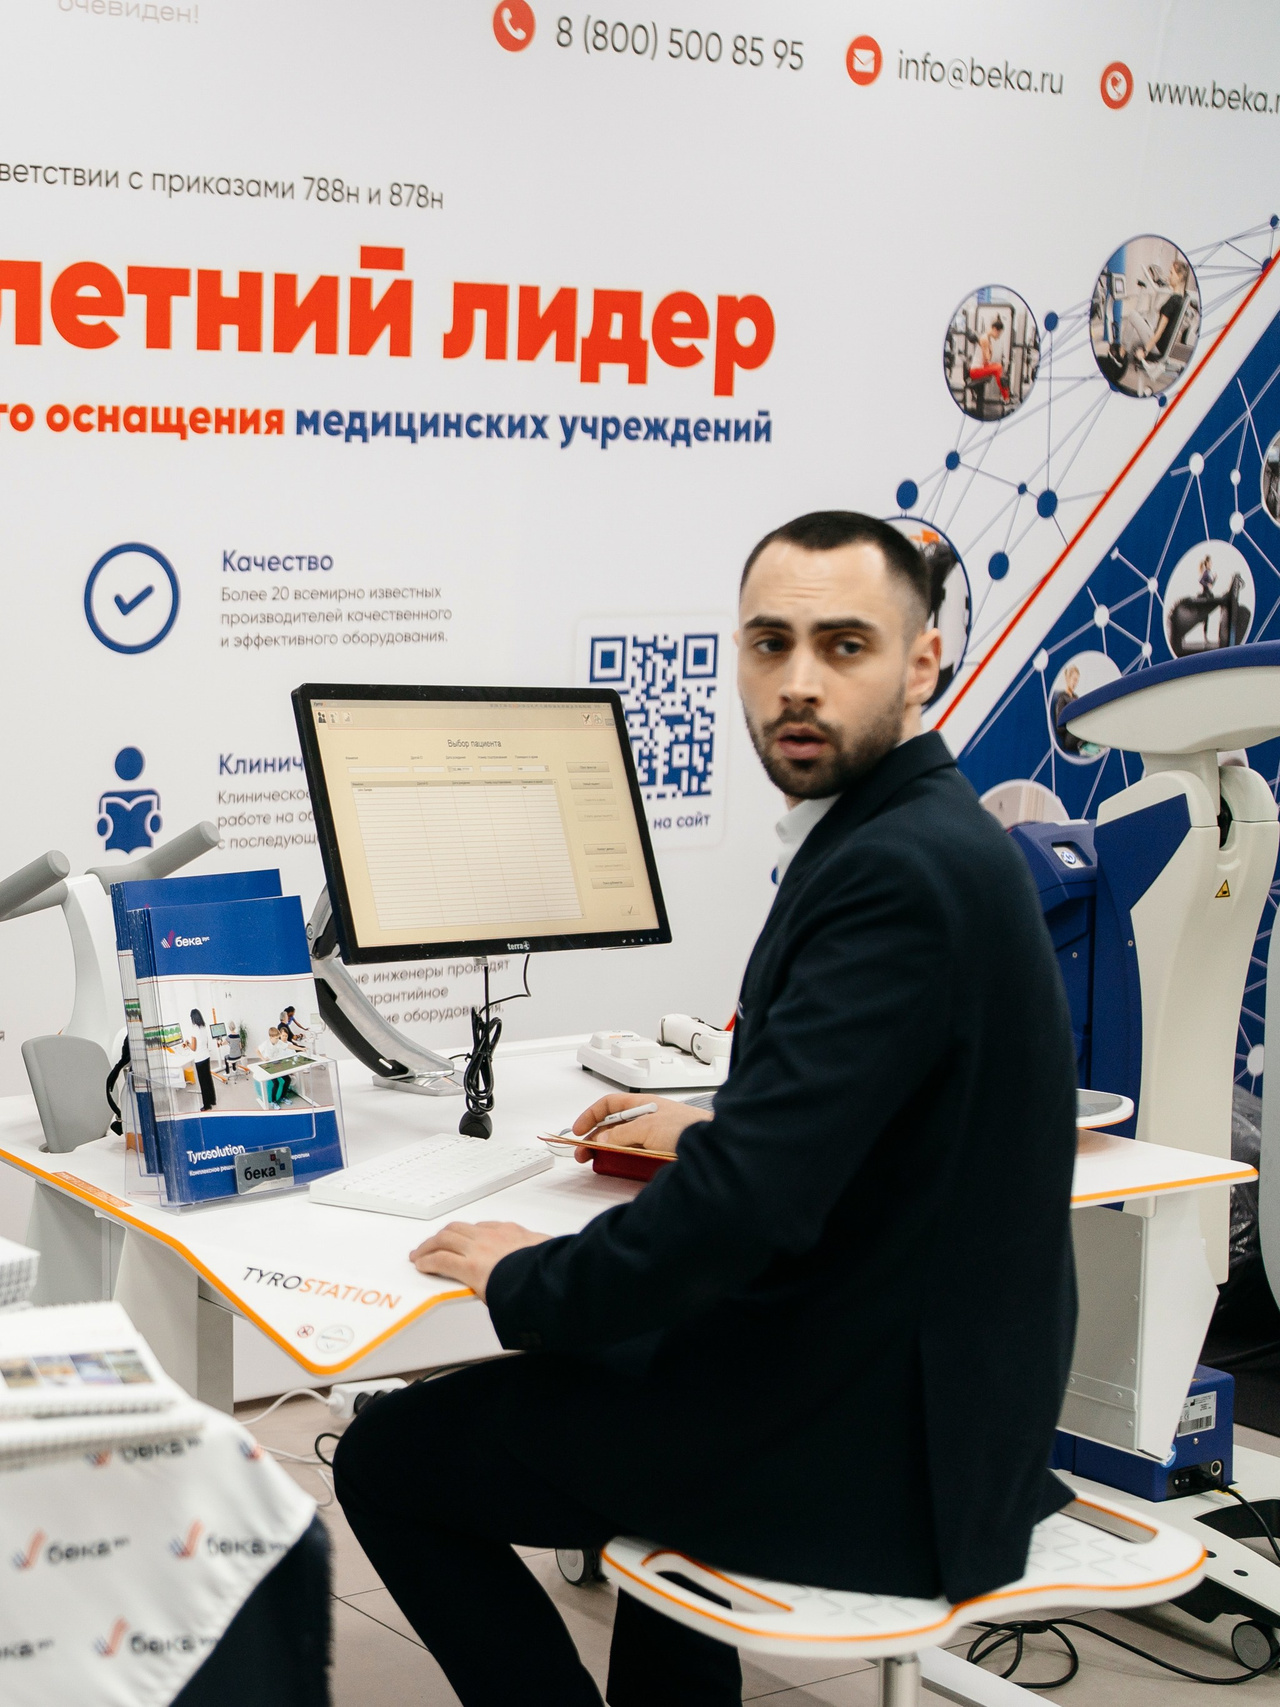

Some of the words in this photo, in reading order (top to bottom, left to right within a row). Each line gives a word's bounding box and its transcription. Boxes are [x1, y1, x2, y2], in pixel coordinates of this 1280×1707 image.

[58, 0, 199, 24] очевиден!
[556, 17, 572, 49] 8
[583, 13, 658, 60] (800)
[668, 28, 723, 64] 500
[732, 35, 765, 68] 85
[773, 39, 804, 71] 95
[898, 50, 1063, 95] info@beka.ru
[128, 170, 142, 191] с
[152, 171, 295, 202] приказами
[303, 176, 360, 205] 788н
[368, 184, 381, 206] и
[389, 182, 444, 210] 878н
[443, 281, 775, 397] лидер
[46, 403, 284, 440] оснащения
[295, 408, 549, 444] медицинских
[559, 410, 773, 449] учреждений
[221, 549, 334, 572] Качество
[221, 586, 267, 602] Более
[272, 586, 290, 601] 20
[294, 587, 365, 603] всемирно
[370, 585, 441, 601] известных
[221, 608, 343, 628] производителей
[347, 608, 452, 623] качественного
[221, 637, 229, 649] и
[234, 632, 338, 650] эффективного
[343, 630, 448, 648] оборудования.
[219, 753, 304, 776] Клинич
[217, 812, 271, 830] работе
[276, 812, 294, 824] на
[654, 818, 672, 829] на
[676, 812, 710, 829] сайт
[230, 833, 317, 849] последующ
[175, 936, 202, 947] бека
[374, 966, 443, 983] инженеры
[186, 1144, 245, 1164] Tyrosolution
[244, 1165, 276, 1180] бека
[243, 1267, 401, 1309] TYROSTATION
